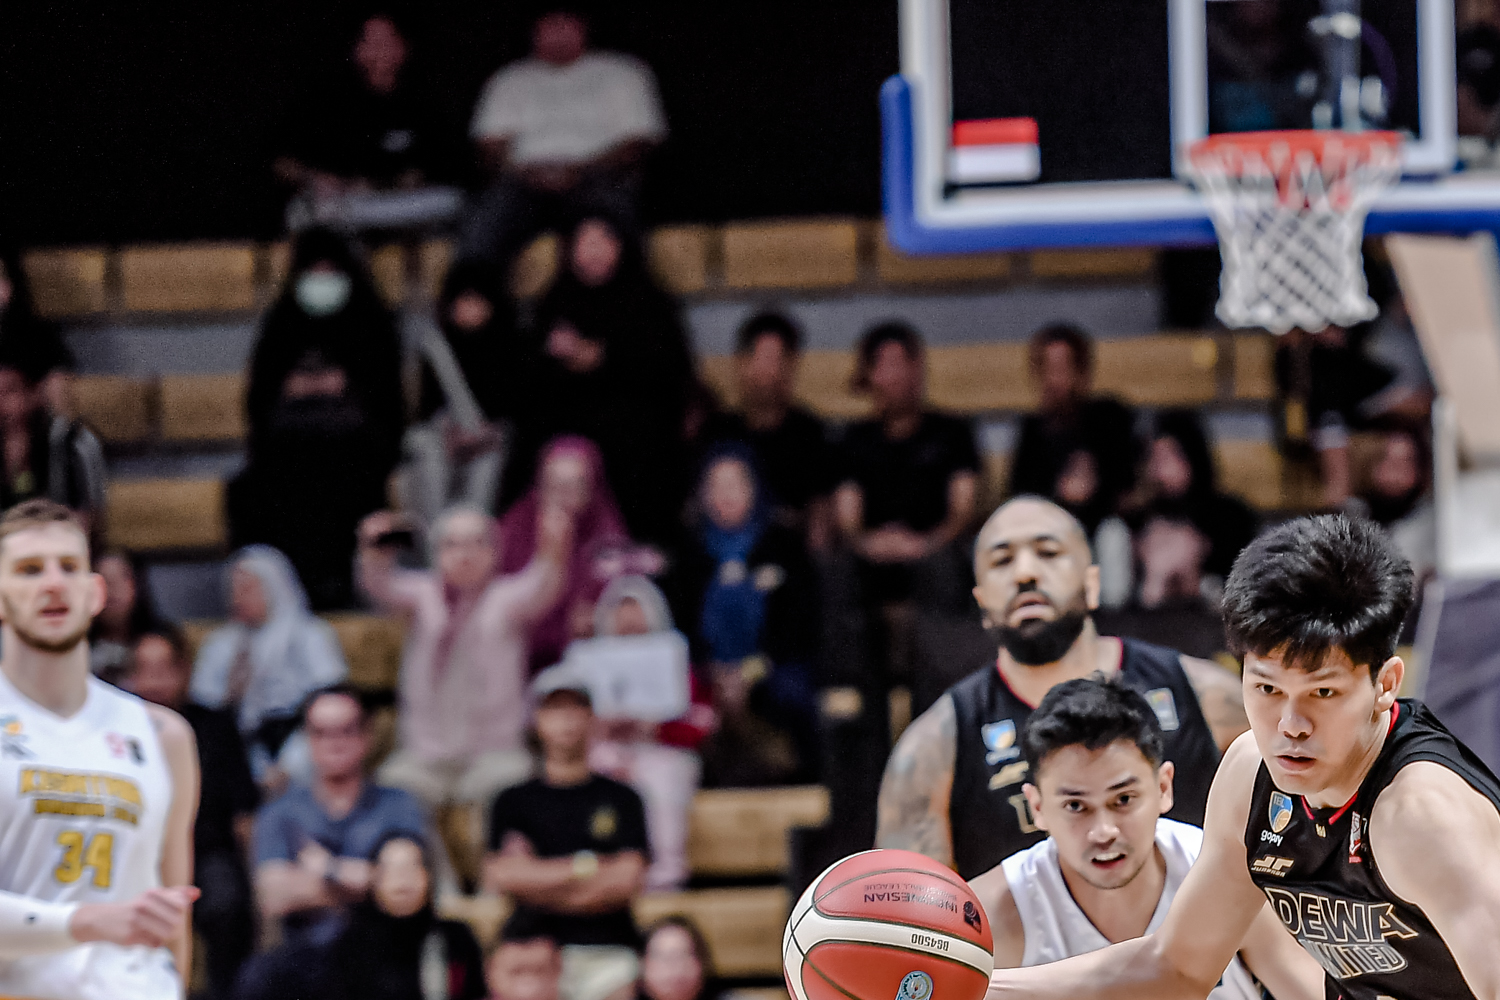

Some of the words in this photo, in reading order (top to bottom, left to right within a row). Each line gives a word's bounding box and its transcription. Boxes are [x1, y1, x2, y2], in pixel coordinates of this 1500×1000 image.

[55, 830, 114, 888] 34
[863, 891, 958, 914] INESIAN
[1264, 887, 1419, 943] DEWA
[911, 933, 950, 951] BG4500
